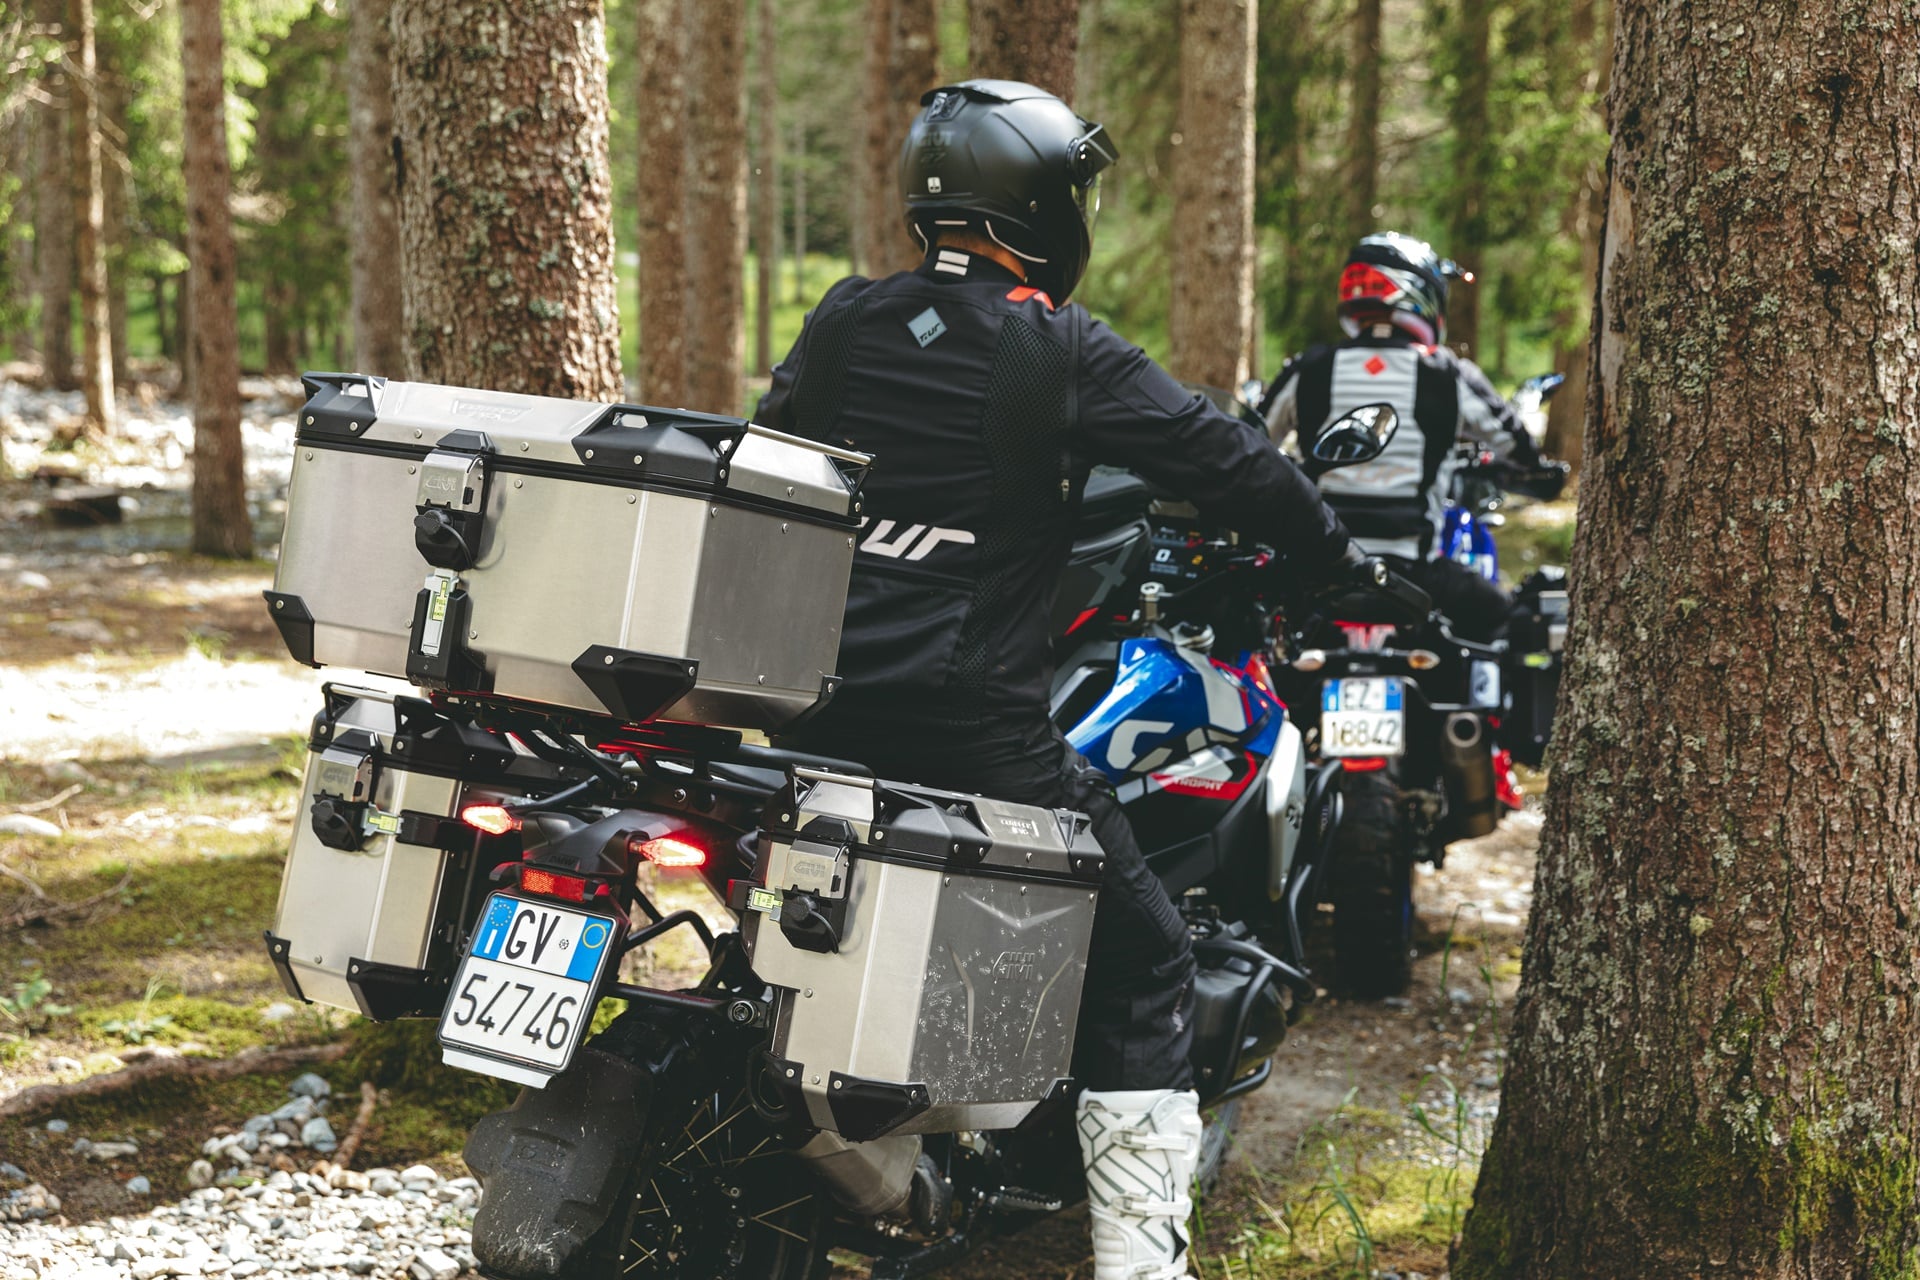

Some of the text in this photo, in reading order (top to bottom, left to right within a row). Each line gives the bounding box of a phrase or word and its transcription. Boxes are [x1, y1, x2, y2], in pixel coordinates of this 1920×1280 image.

[1343, 681, 1370, 710] EZ
[504, 909, 561, 965] GV
[453, 973, 577, 1050] 54746
